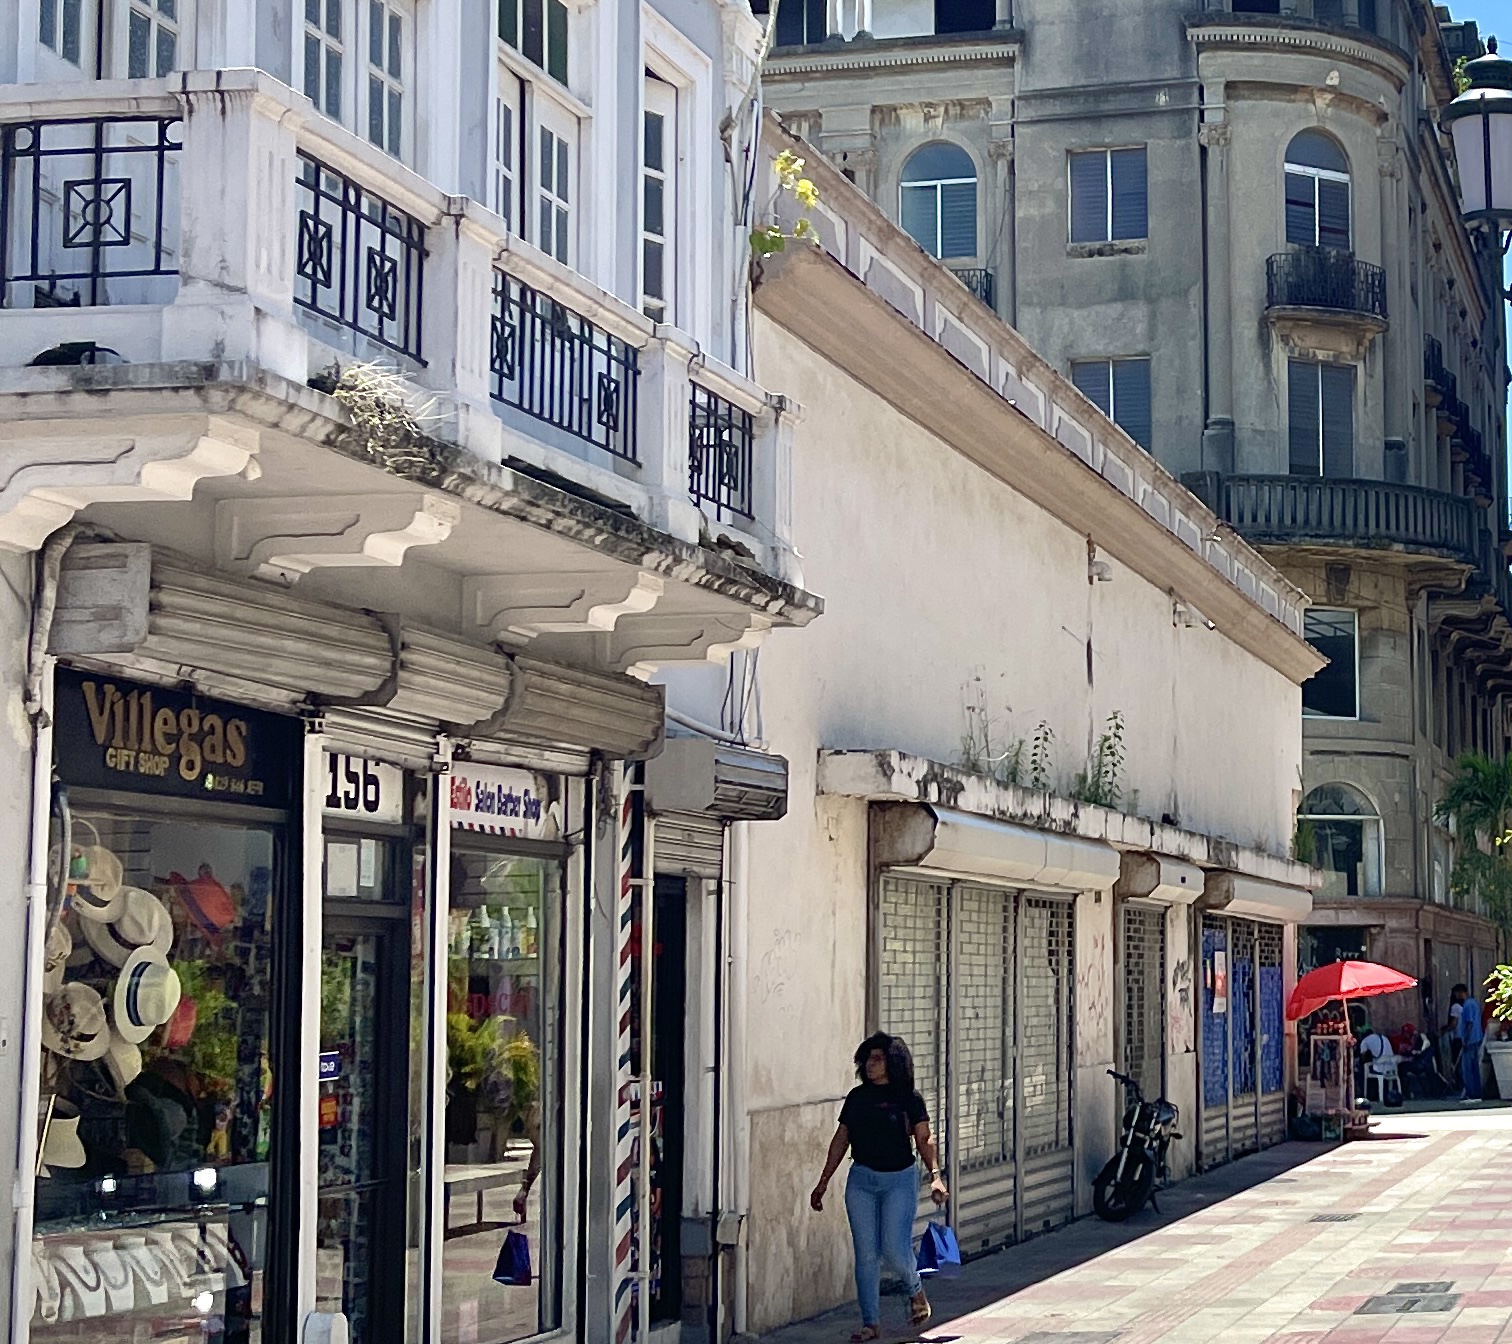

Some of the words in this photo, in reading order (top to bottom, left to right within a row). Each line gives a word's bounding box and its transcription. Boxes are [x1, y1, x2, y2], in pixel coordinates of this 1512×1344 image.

[82, 681, 248, 781] Villegas
[105, 746, 137, 772] GIFT
[137, 752, 170, 777] SHOP
[496, 783, 521, 818] Barber
[522, 788, 542, 827] Shop
